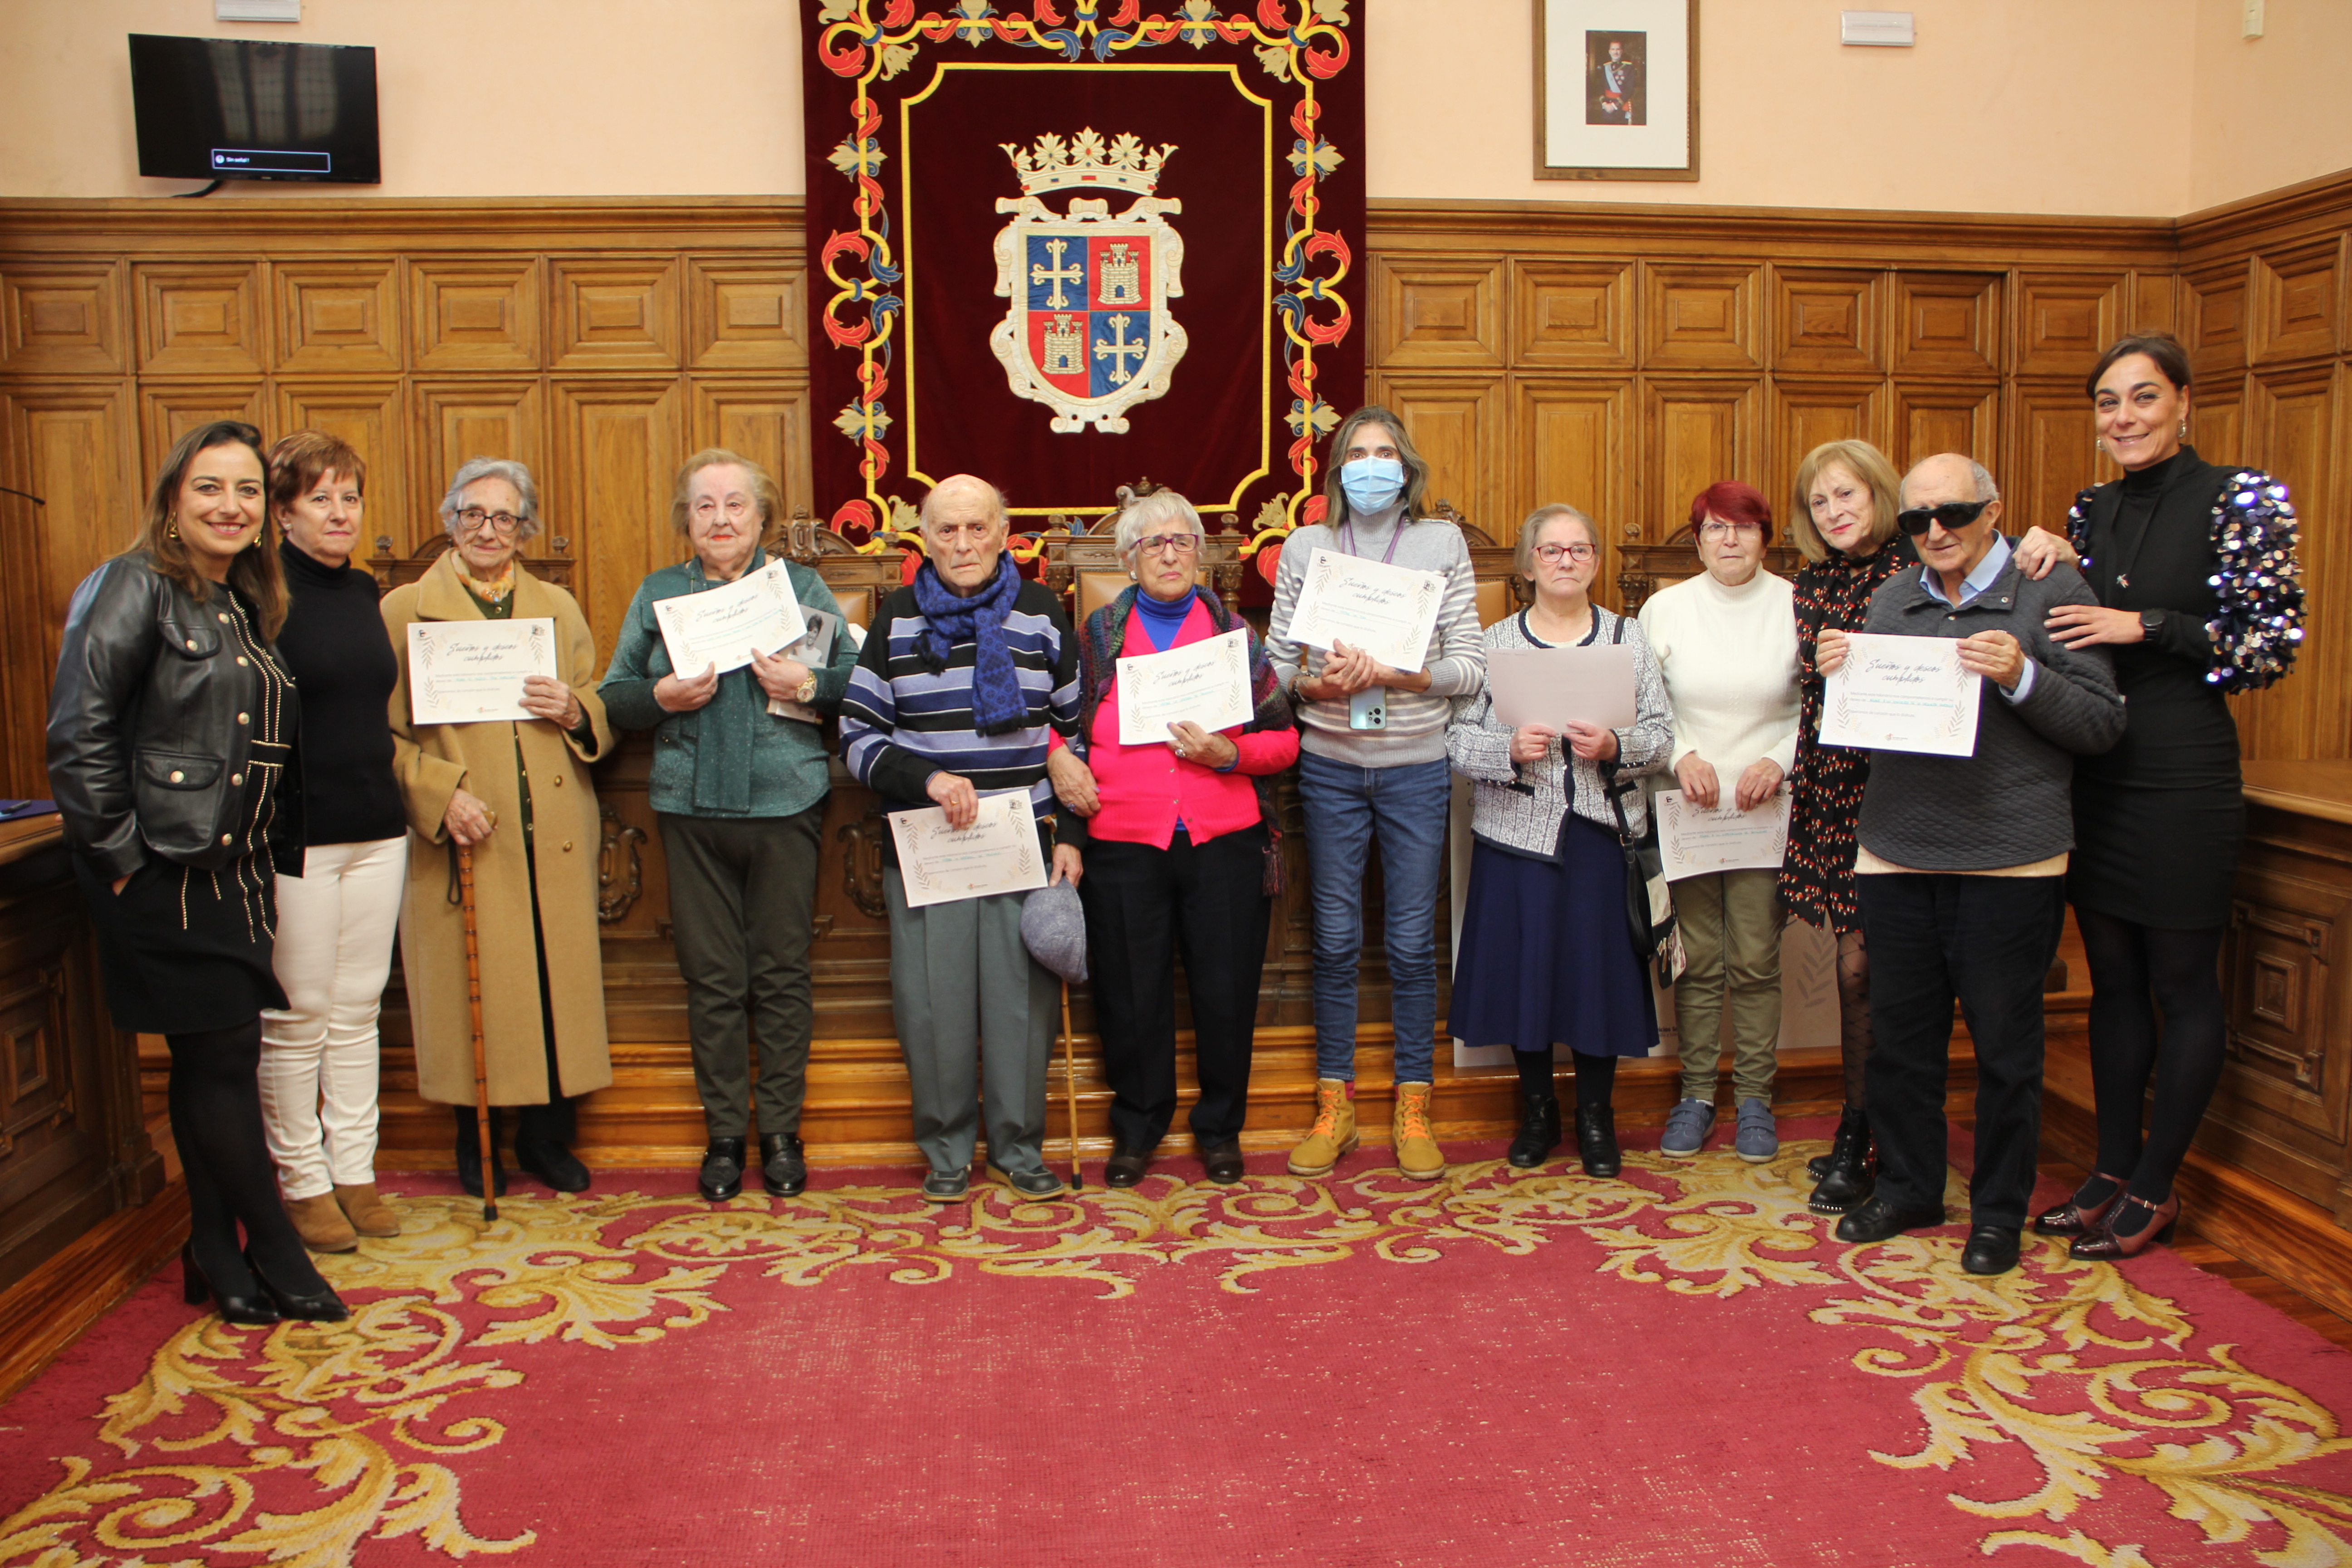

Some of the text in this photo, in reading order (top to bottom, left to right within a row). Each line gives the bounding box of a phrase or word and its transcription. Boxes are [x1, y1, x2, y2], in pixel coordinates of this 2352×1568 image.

[1338, 577, 1371, 591] Sueños
[1382, 588, 1407, 599] deseos
[1865, 658, 1900, 673] Sueños
[1913, 663, 1943, 673] deseos
